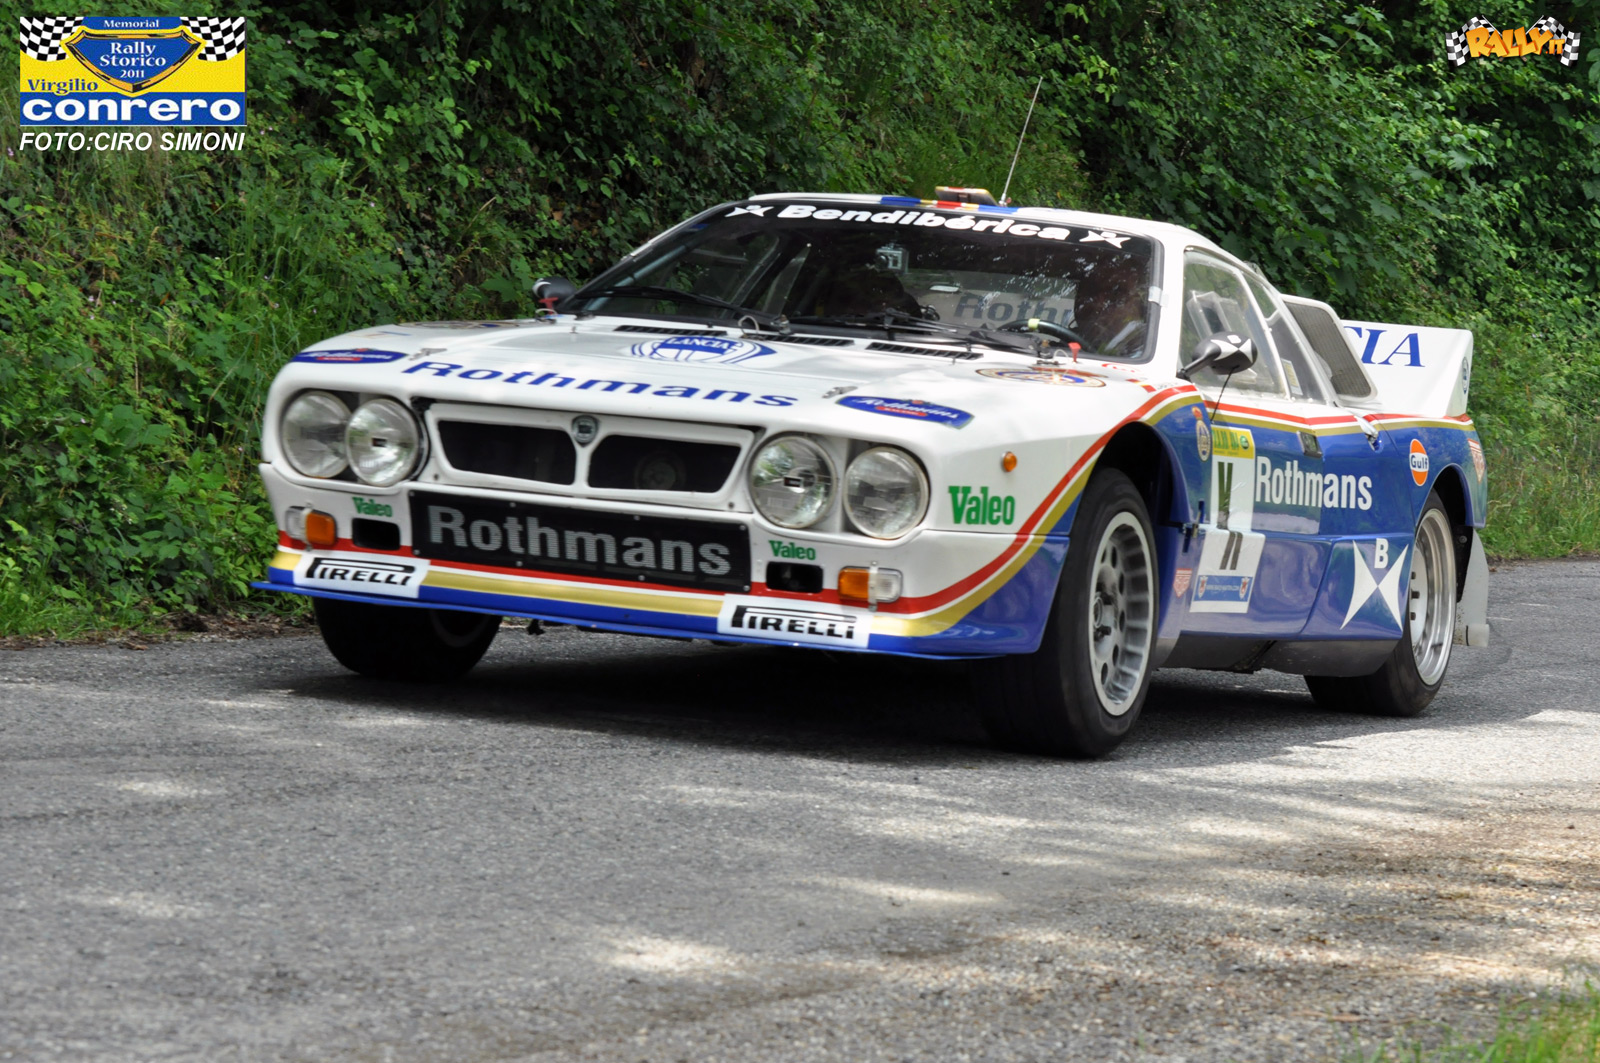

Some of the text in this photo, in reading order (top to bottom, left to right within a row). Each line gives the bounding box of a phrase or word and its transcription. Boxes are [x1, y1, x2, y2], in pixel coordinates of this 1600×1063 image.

[777, 204, 1071, 241] Bendibérica
[666, 337, 731, 350] LANCIA
[400, 360, 798, 407] Rothmans
[1409, 454, 1429, 470] Gulf
[1255, 455, 1373, 511] Rothmans
[352, 496, 393, 517] Valeo
[948, 485, 1016, 526] Valeo
[427, 504, 732, 577] Rothmans
[768, 539, 816, 561] Valeo
[1373, 537, 1390, 569] B
[305, 557, 416, 587] PIRELLI
[730, 604, 857, 640] PIRELLI
